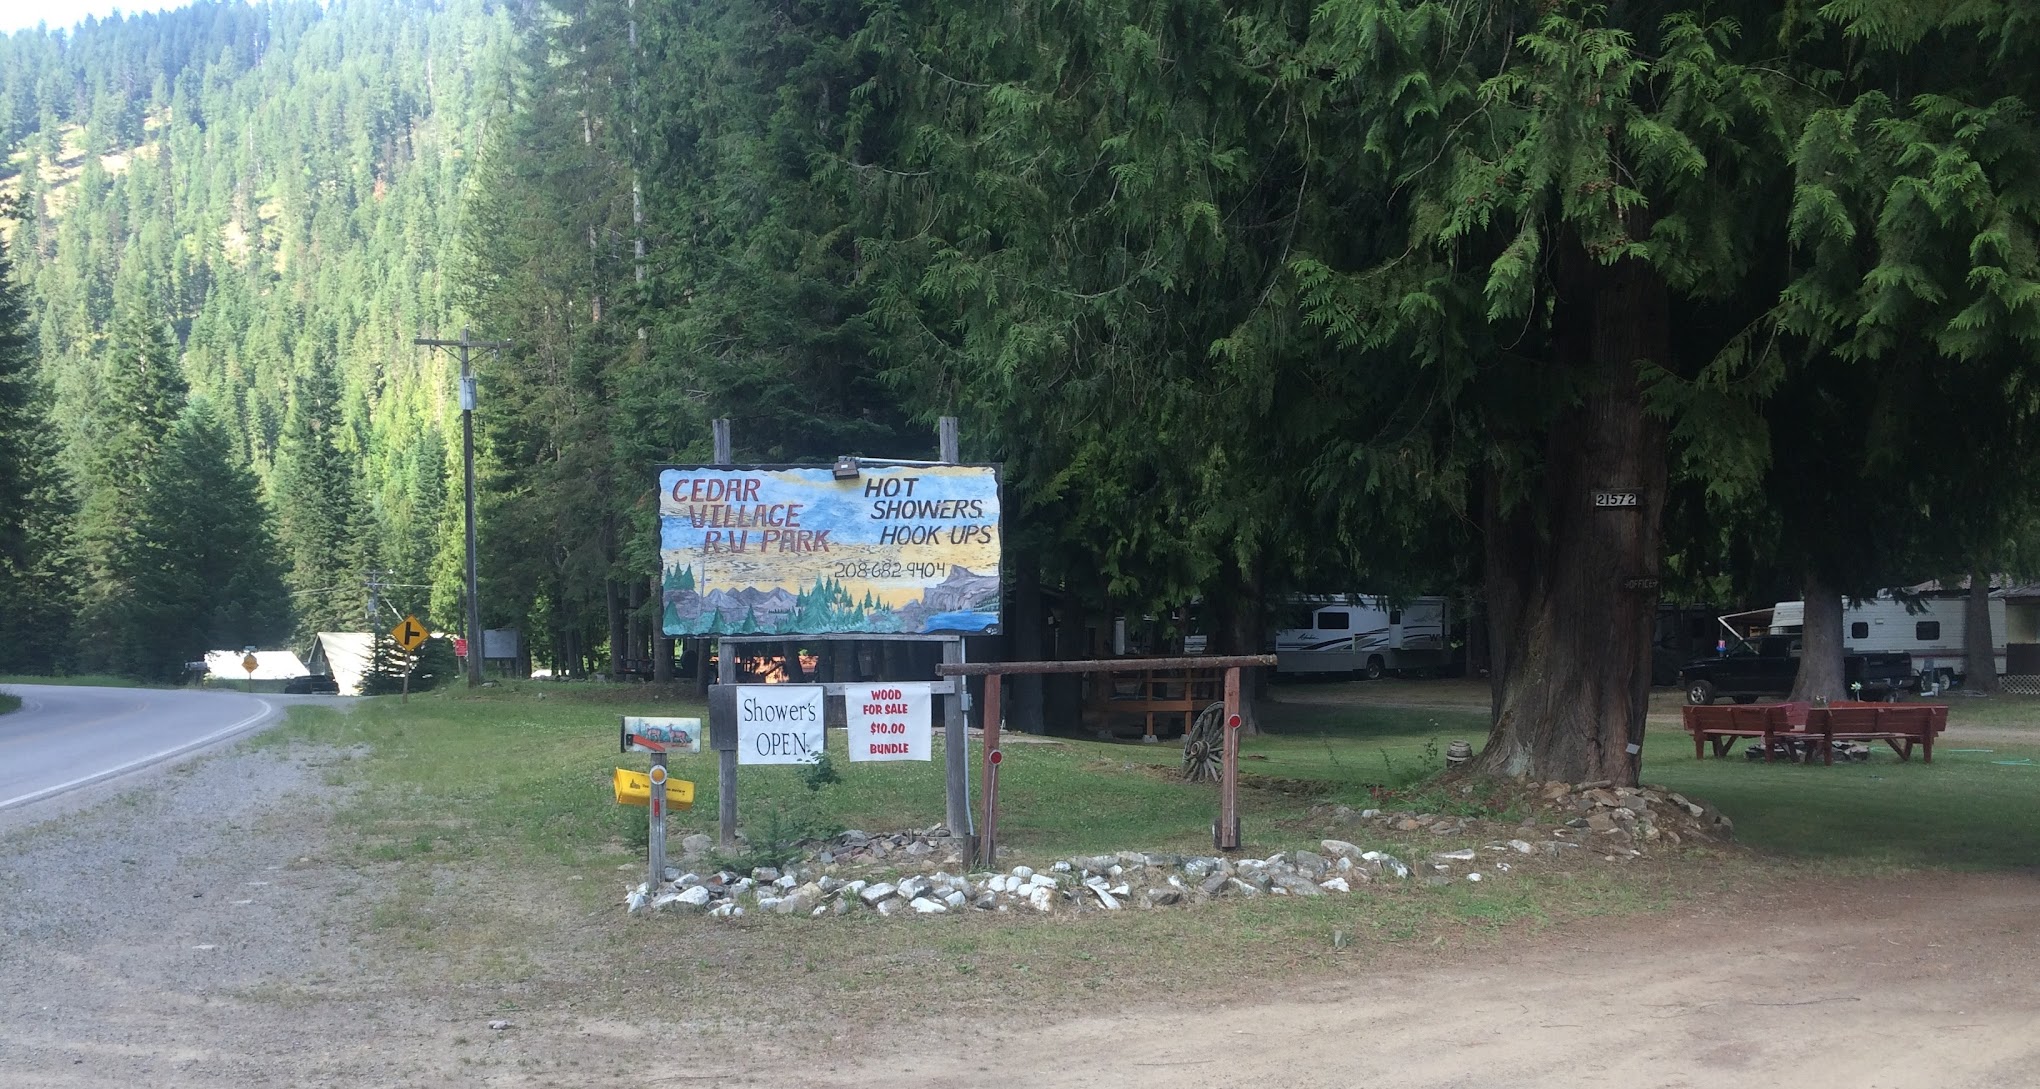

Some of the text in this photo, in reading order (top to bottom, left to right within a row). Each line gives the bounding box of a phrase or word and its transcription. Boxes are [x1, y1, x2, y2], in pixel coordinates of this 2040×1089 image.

[672, 478, 761, 502] CEDAR
[864, 477, 920, 498] HOT
[871, 499, 983, 520] SHOWERS
[1597, 494, 1635, 505] 21572
[688, 503, 804, 529] VILLAGE
[703, 529, 831, 553] RV PARK
[879, 525, 992, 545] HOOK UPS
[834, 562, 946, 579] 208-682-9404
[870, 689, 902, 700] WOOD
[744, 699, 816, 722] Shower's
[863, 703, 909, 715] FOR SALE
[870, 722, 905, 735] $10.00
[756, 732, 806, 756] OPEN
[869, 742, 909, 755] BUNDLE
